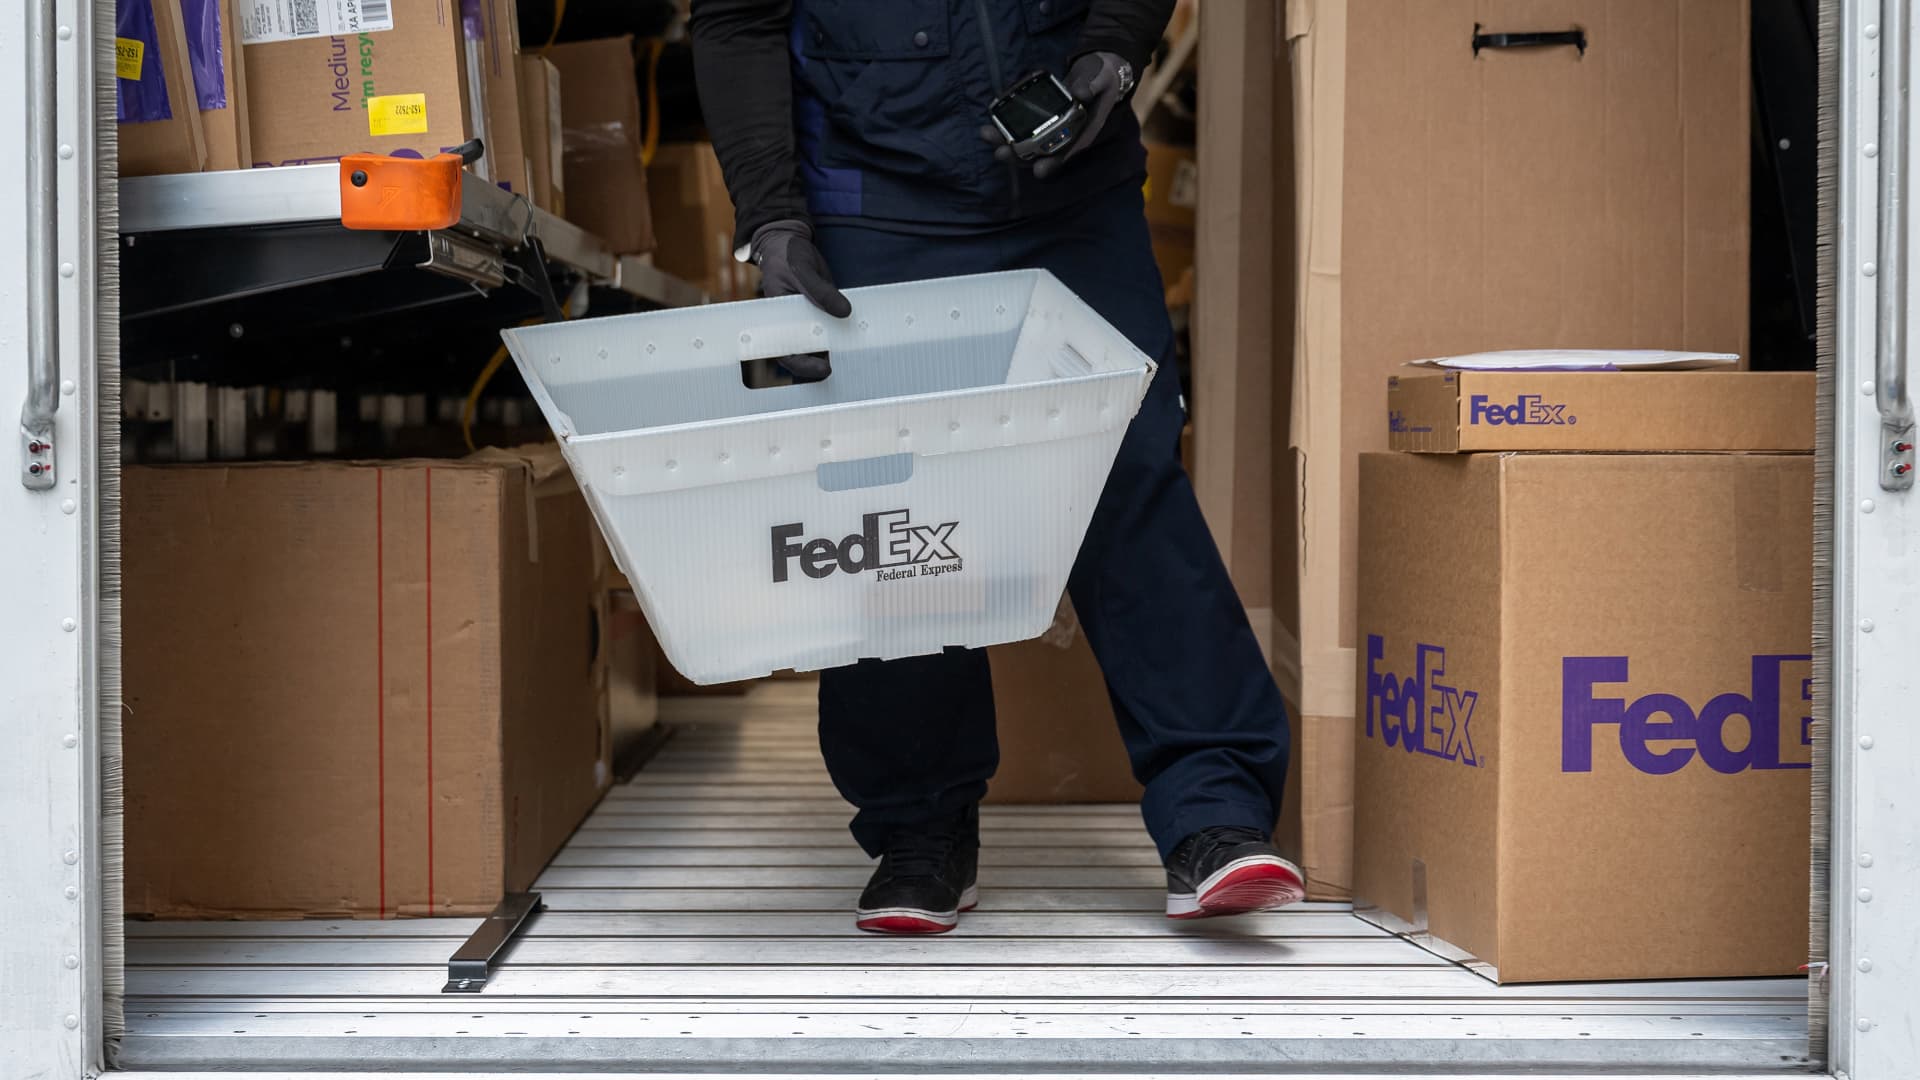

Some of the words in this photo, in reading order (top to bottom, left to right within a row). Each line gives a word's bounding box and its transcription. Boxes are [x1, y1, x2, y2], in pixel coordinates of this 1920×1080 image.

[358, 32, 374, 76] recy
[1470, 395, 1567, 425] FedEx
[771, 508, 960, 583] FedEx
[876, 566, 917, 582] Federal
[921, 562, 963, 577] Express
[1366, 634, 1478, 767] FedEx
